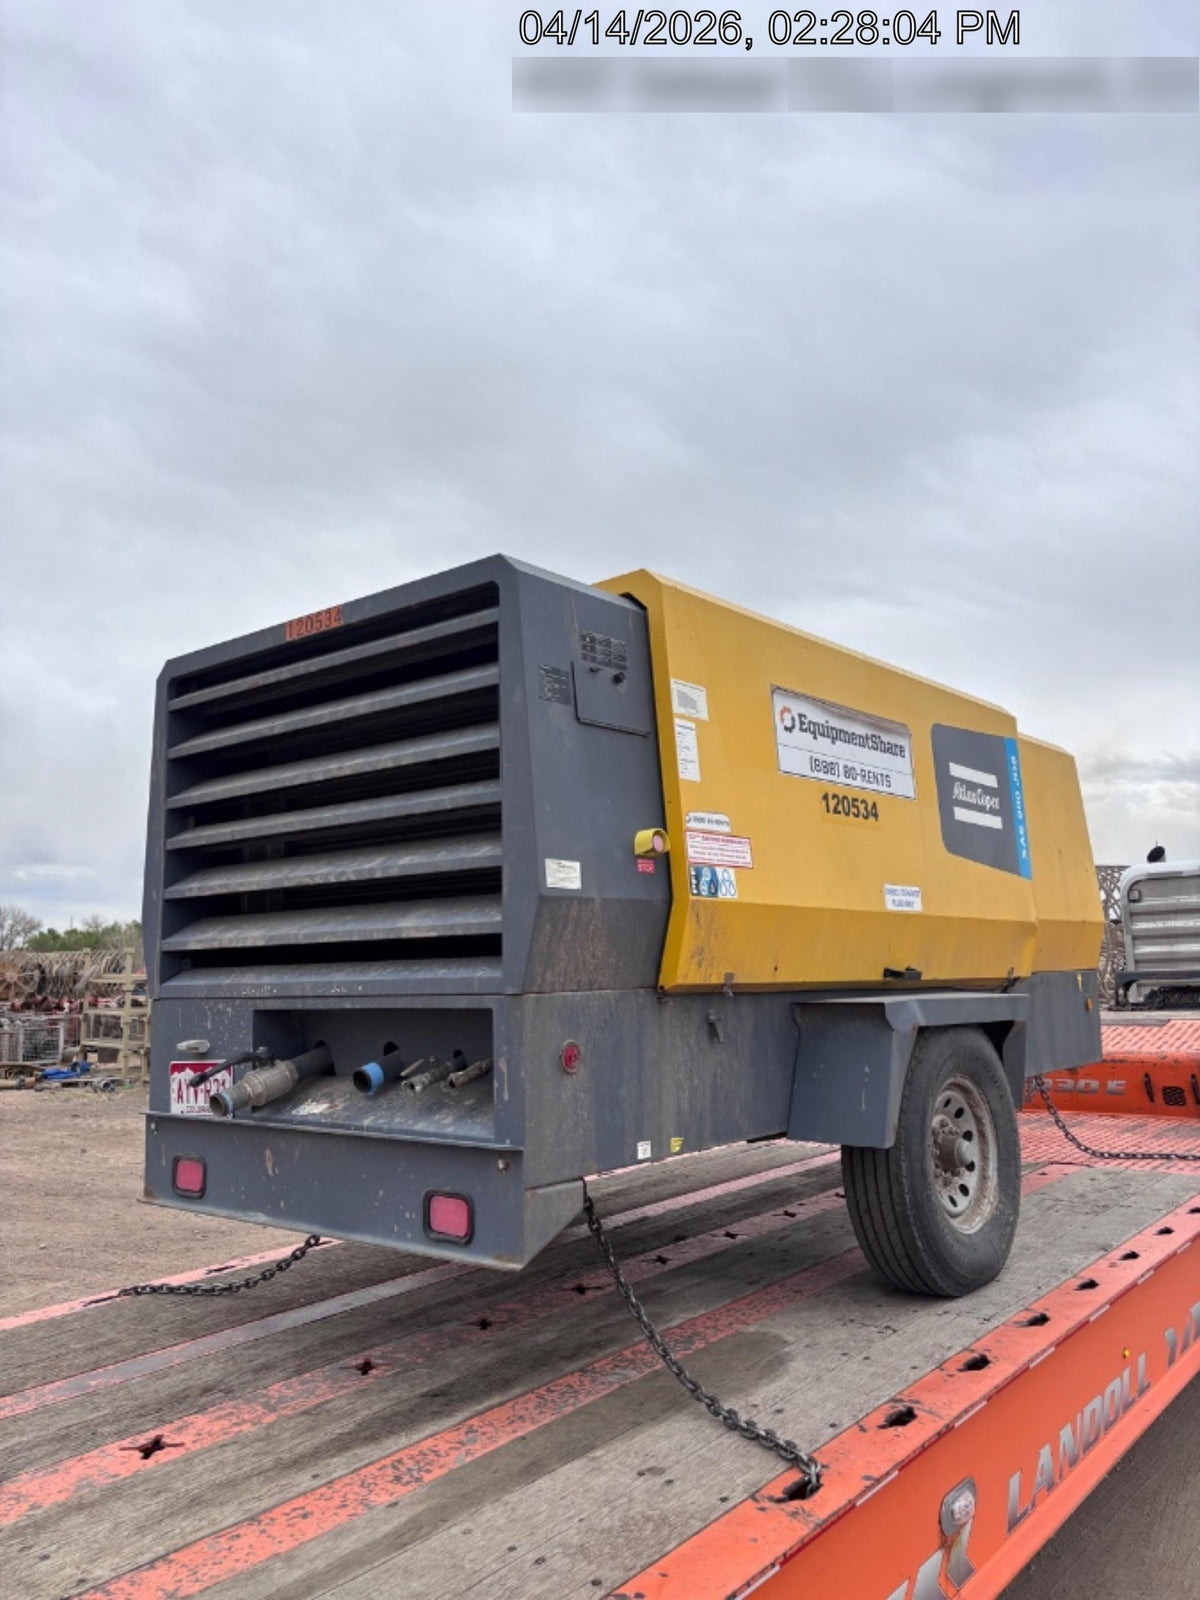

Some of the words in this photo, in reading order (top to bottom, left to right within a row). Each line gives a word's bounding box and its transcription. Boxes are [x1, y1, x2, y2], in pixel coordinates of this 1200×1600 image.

[287, 606, 342, 638] 120534
[797, 713, 906, 758] EquipmentShare
[810, 755, 840, 778] (888)
[843, 764, 891, 788] 80-RENTS
[821, 792, 879, 821] 120534
[1106, 1080, 1127, 1095] E
[1007, 1351, 1151, 1536] LANDOLL
